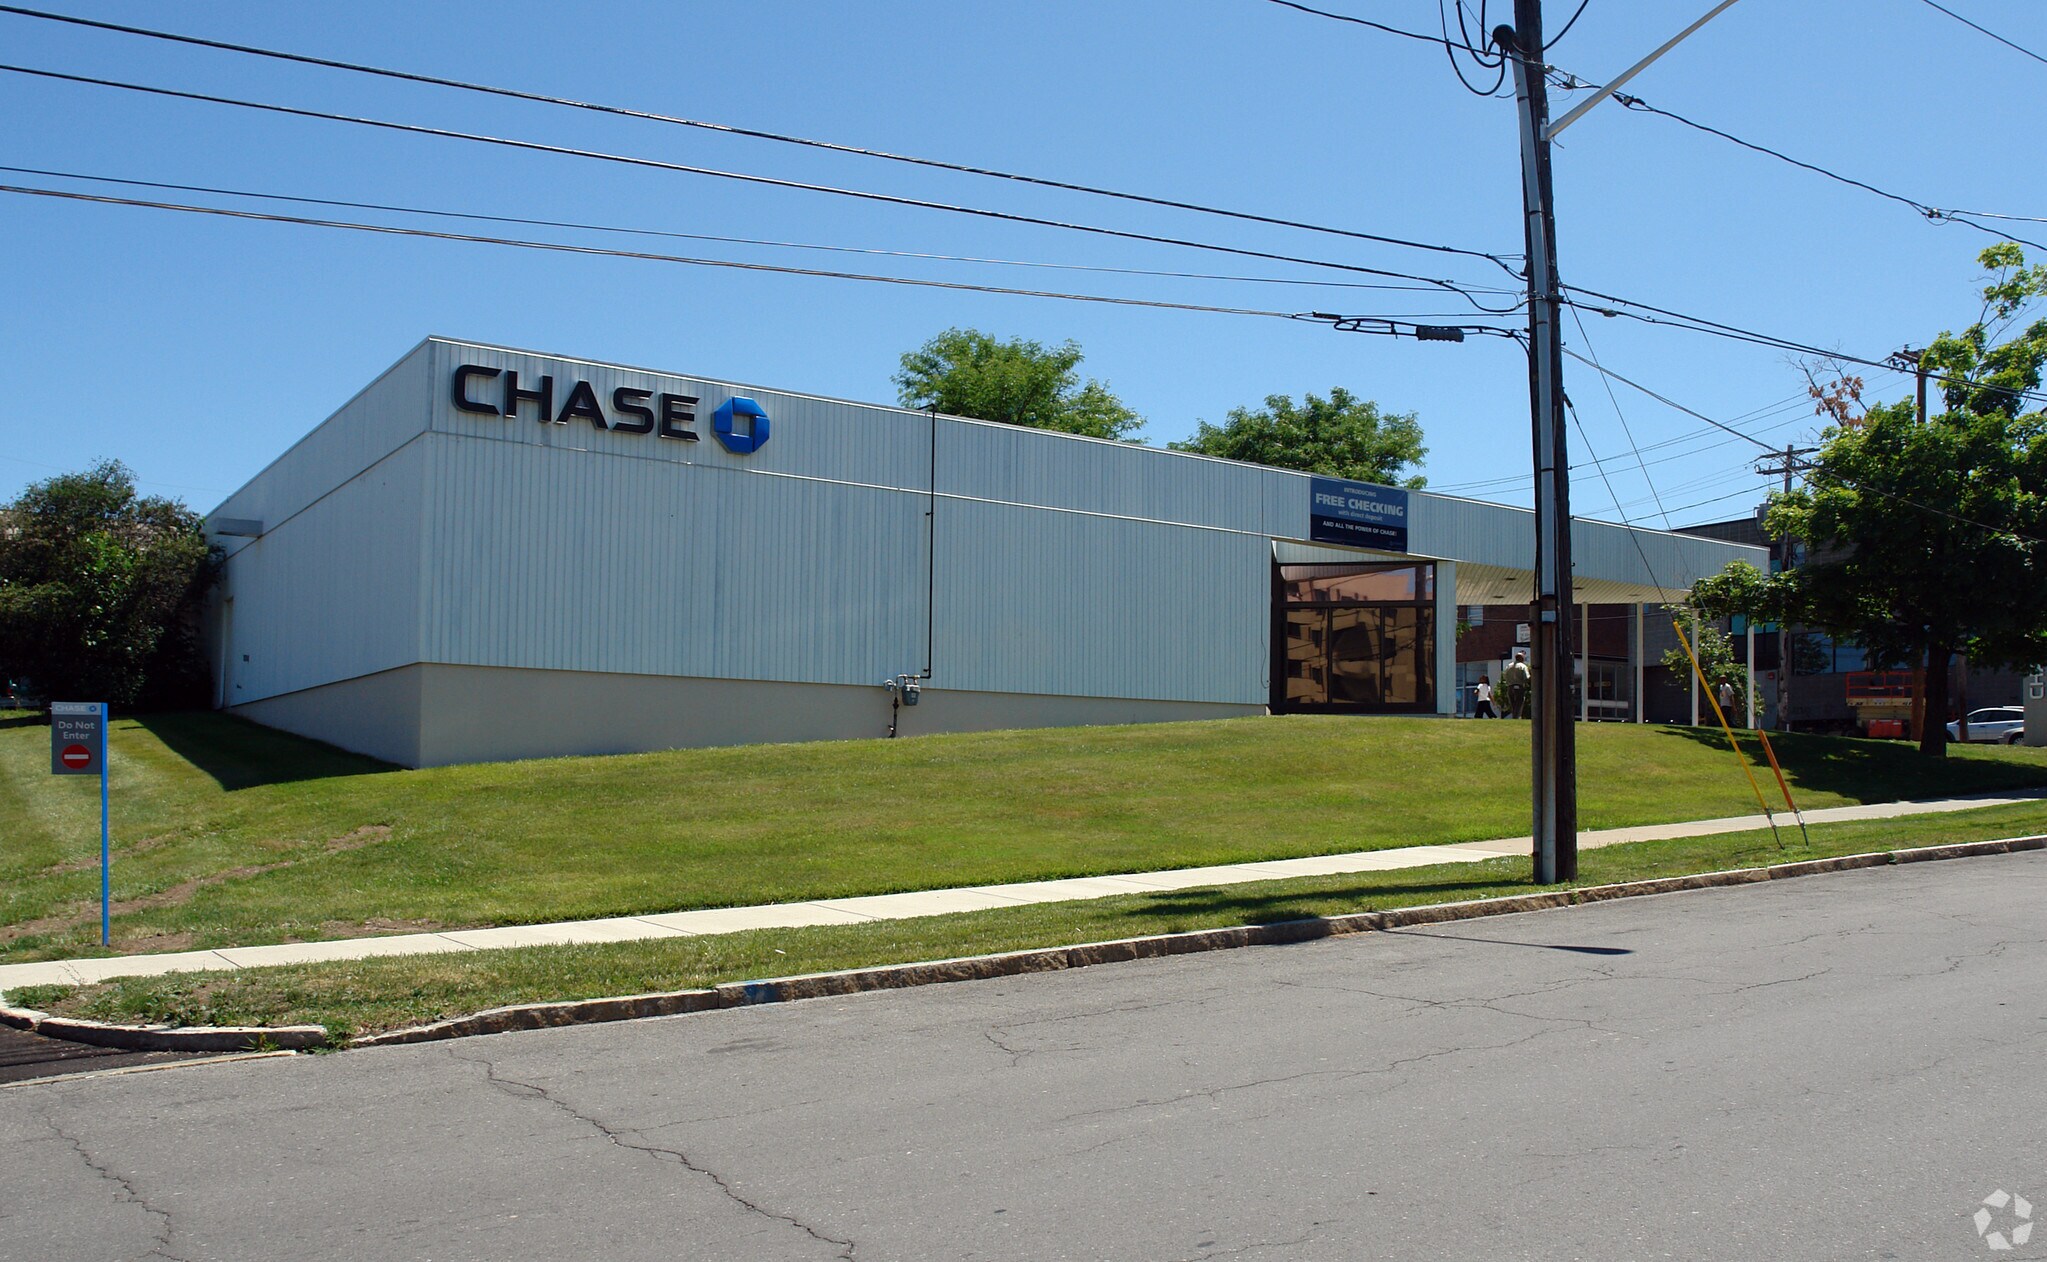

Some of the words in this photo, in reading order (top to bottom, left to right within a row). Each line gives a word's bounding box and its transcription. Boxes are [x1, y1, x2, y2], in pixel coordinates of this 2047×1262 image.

[453, 364, 700, 442] CHASE
[1315, 493, 1345, 508] FREE
[1348, 498, 1404, 516] CHECKING
[1322, 520, 1334, 528] AND
[1354, 525, 1372, 533] POWER
[58, 721, 73, 729] Do
[75, 721, 95, 730] Not
[63, 731, 90, 740] Enter
